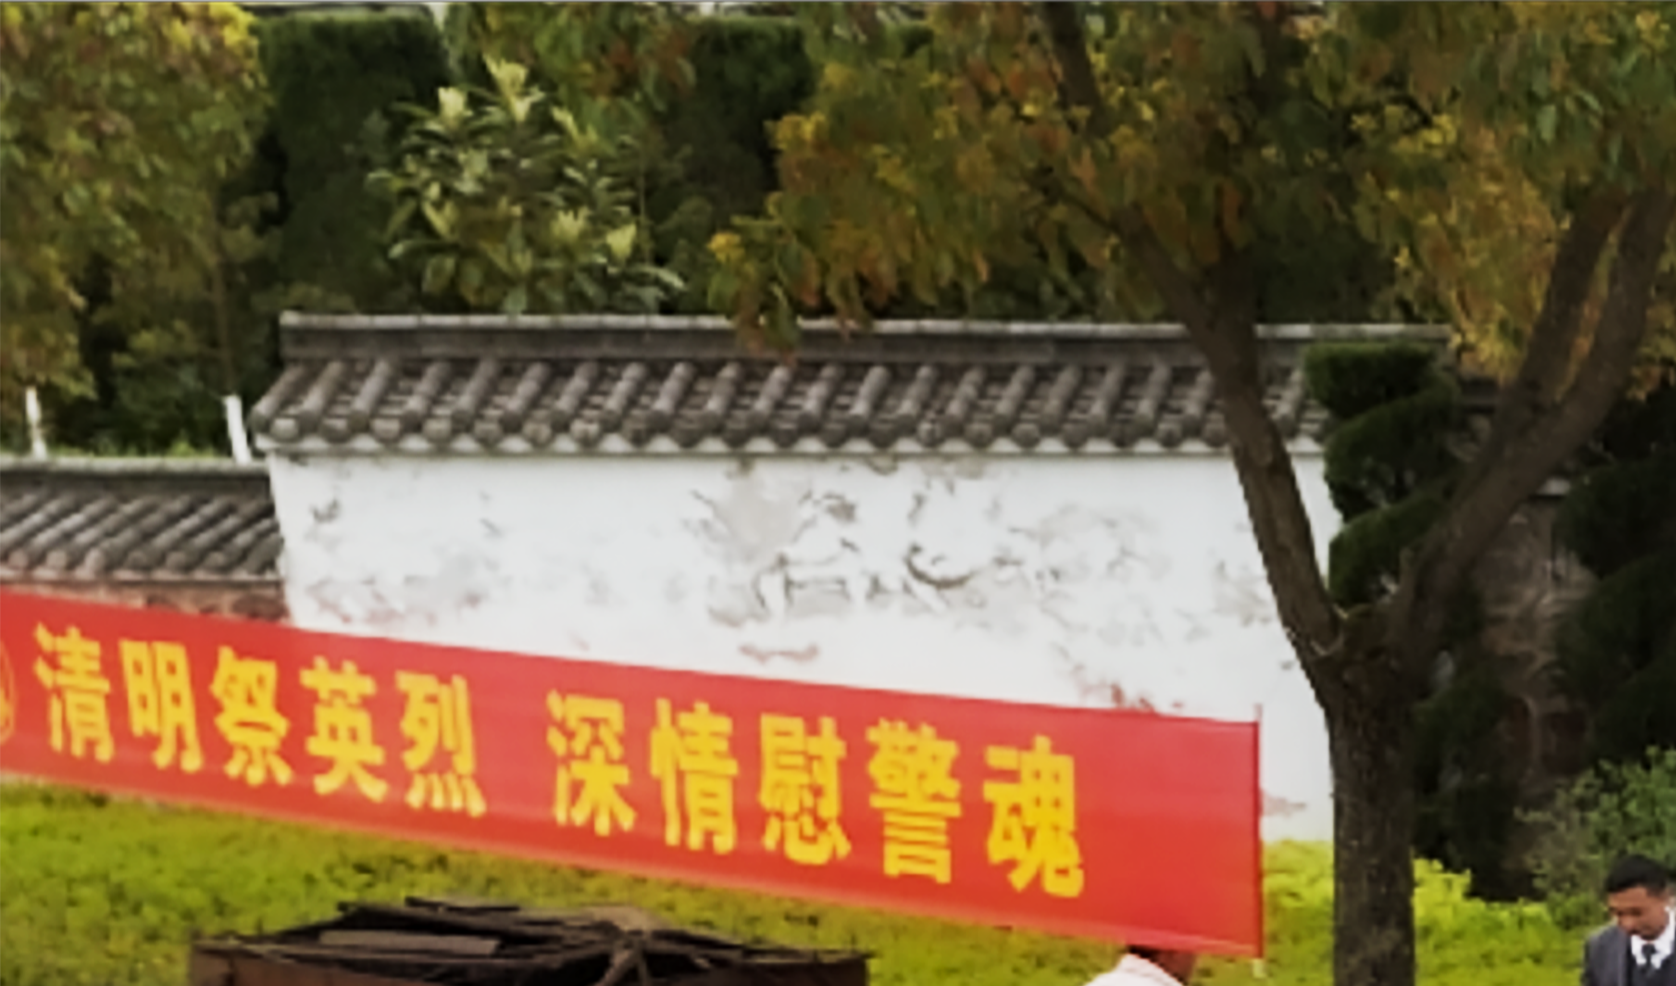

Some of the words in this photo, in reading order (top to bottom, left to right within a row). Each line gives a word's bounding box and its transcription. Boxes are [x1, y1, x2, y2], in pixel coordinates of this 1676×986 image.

[33, 622, 487, 818] 清明祭英烈
[546, 688, 1085, 898] 深情慰警魂
